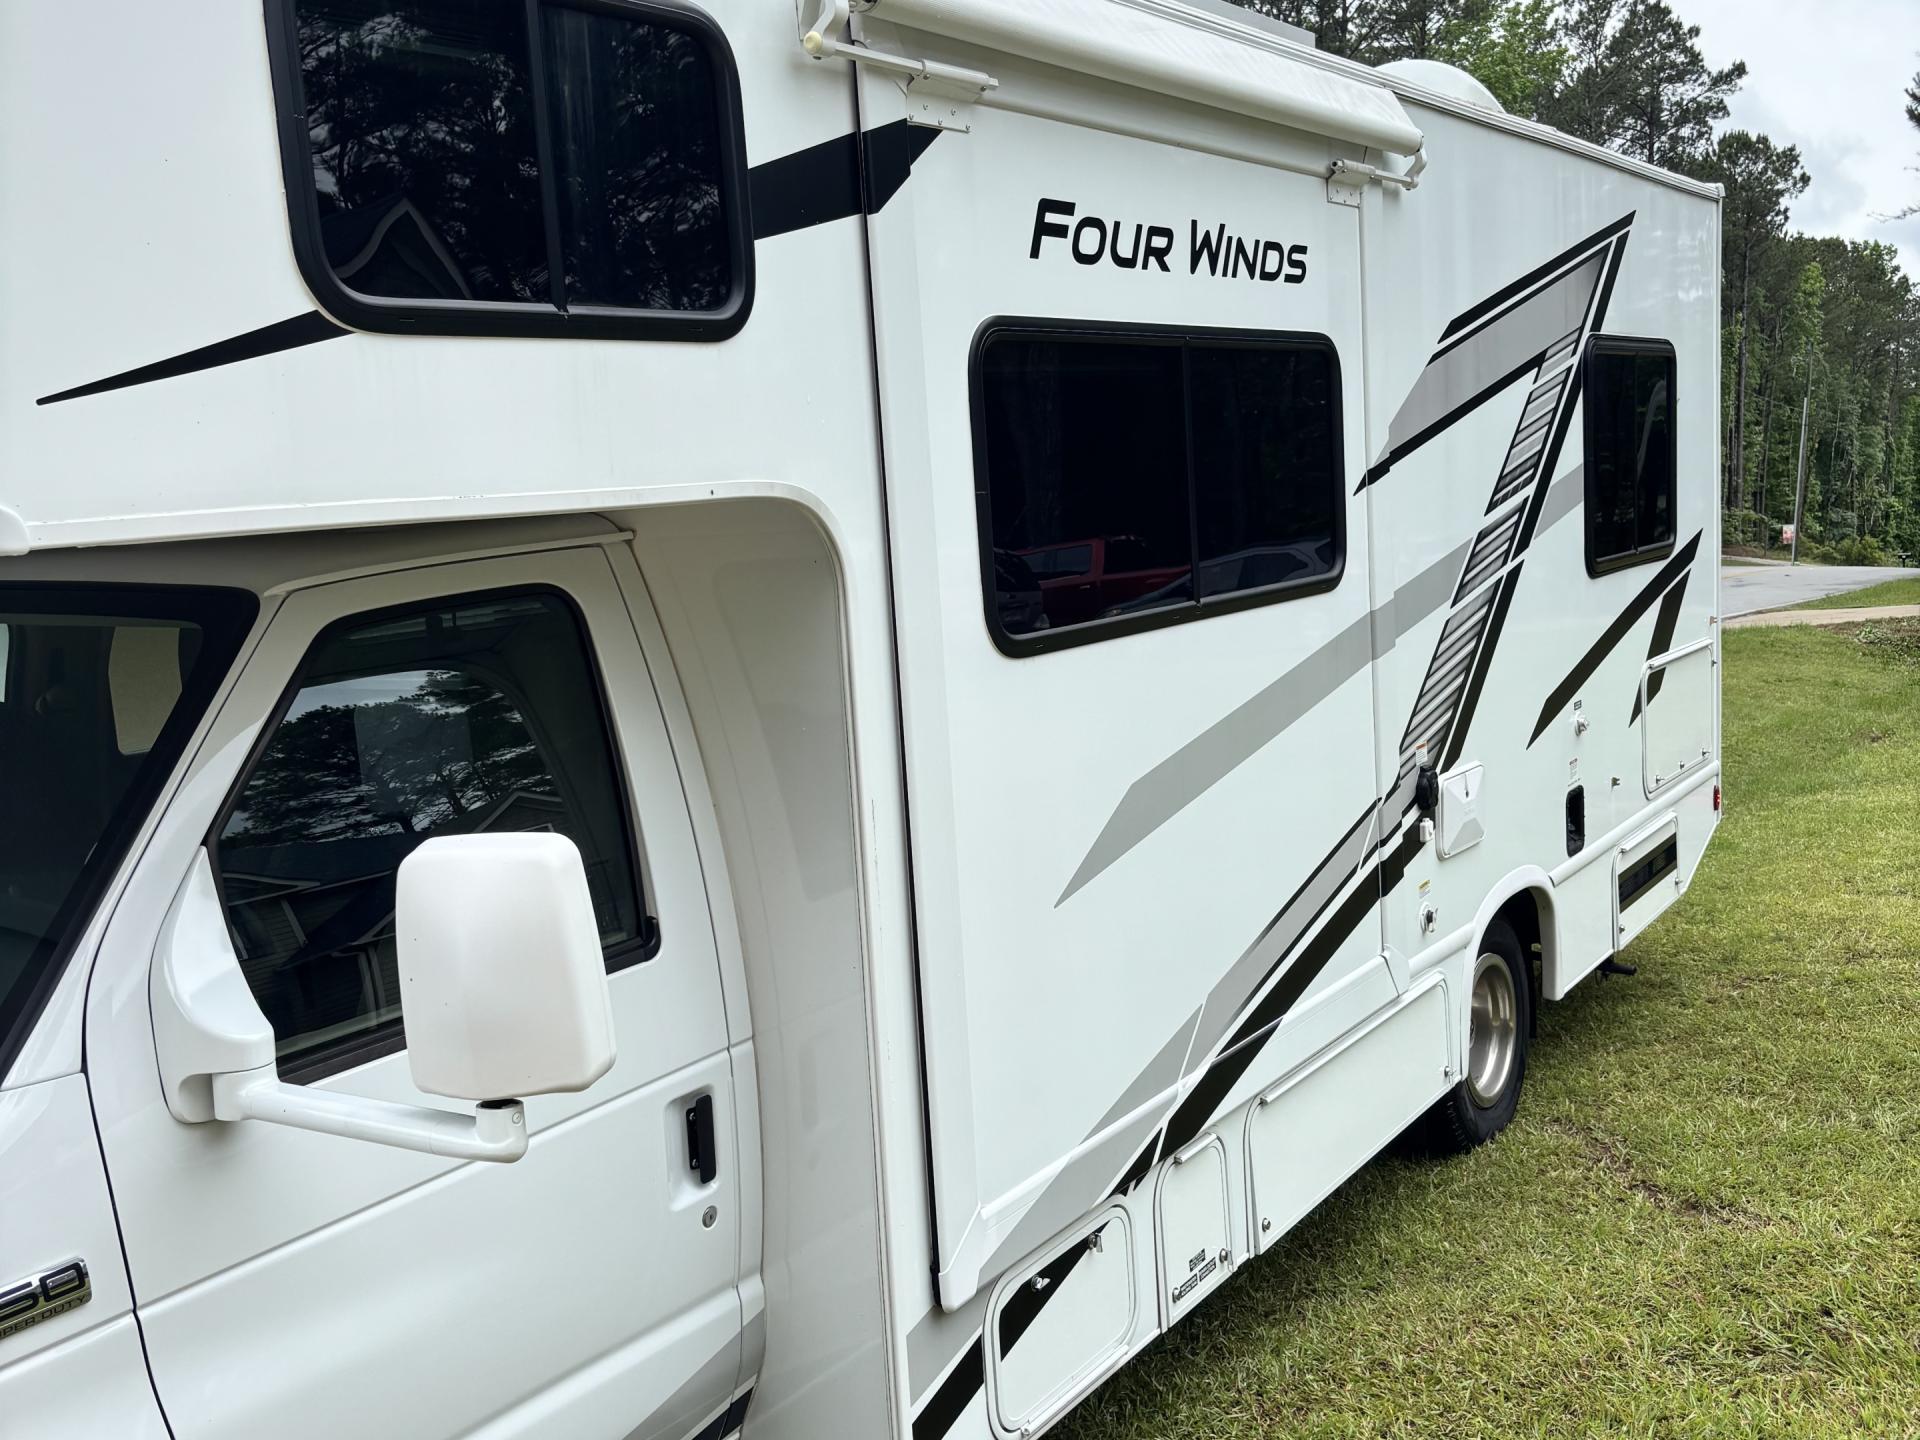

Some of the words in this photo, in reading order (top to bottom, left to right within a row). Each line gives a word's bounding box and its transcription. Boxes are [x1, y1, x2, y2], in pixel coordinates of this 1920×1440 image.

[1029, 197, 1174, 272] FOUR
[1190, 219, 1308, 284] WINDS
[0, 1317, 36, 1338] PER
[41, 1295, 85, 1320] DUTY
